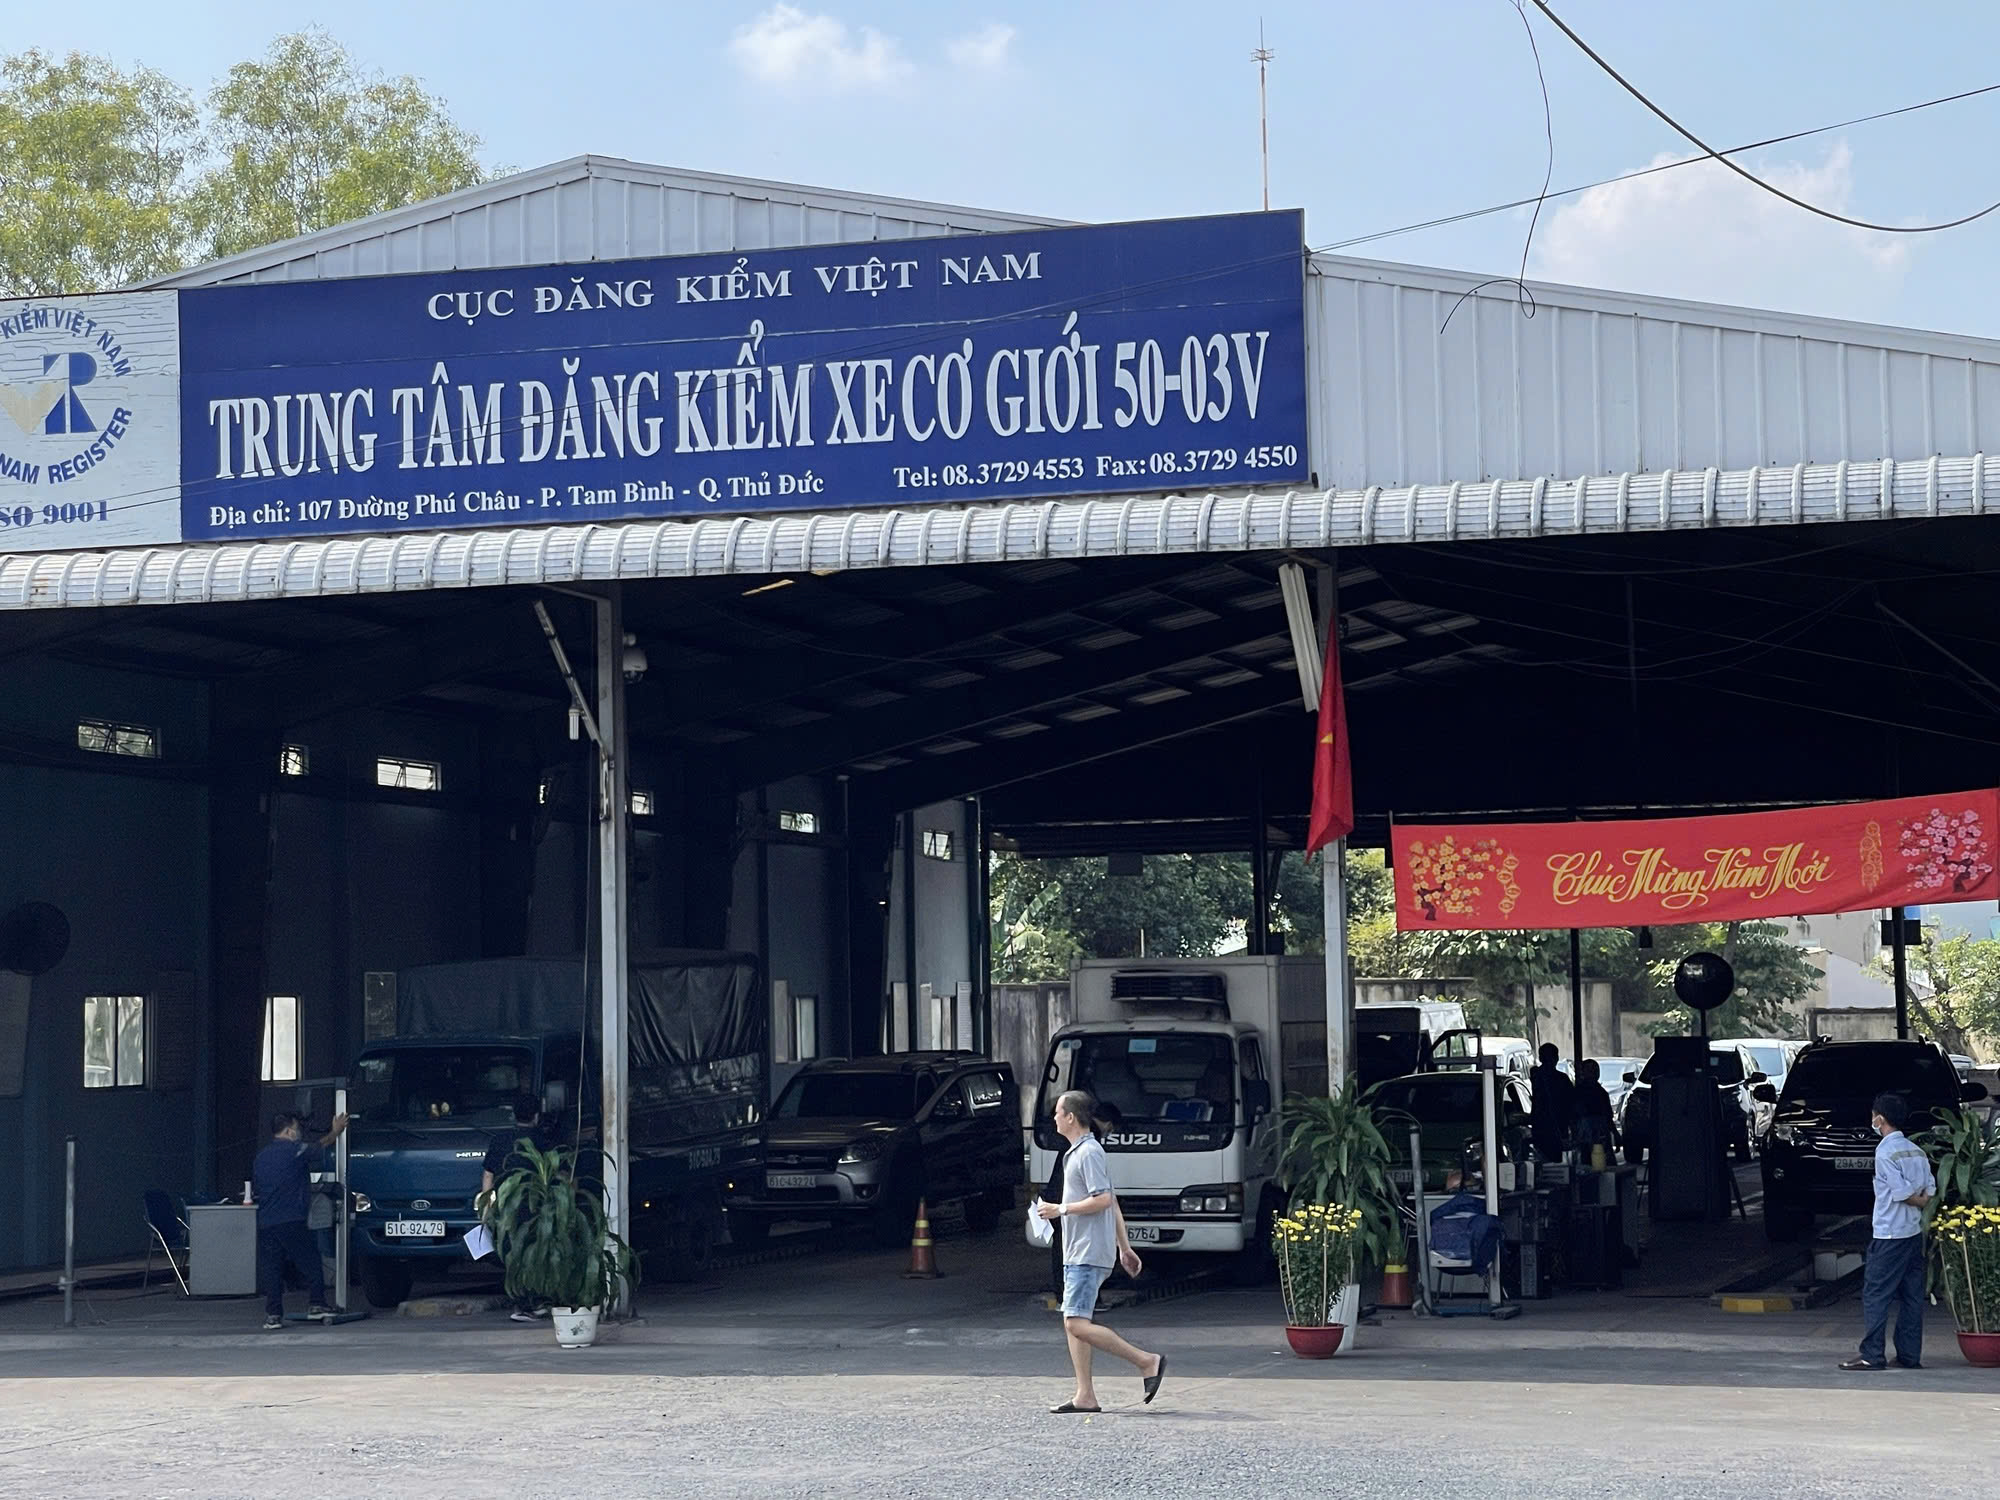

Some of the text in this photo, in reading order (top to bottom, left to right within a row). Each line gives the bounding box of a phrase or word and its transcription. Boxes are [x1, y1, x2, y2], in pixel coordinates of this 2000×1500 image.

[428, 251, 1042, 326] CỤC ĐĂNG KIỂM VIỆT NAM
[54, 308, 97, 338] VIỆT
[96, 330, 131, 378] NAM
[209, 310, 1270, 480] TRUNG TÂM ĐĂNG KIỂM XE CƠ GIỚI 50-03V
[48, 406, 132, 484] REGISTER
[894, 466, 938, 488] Tel:
[1096, 455, 1146, 477] Fax:
[1244, 444, 1298, 468] 4550
[43, 500, 107, 525] 9001
[210, 506, 247, 529] Địa
[252, 500, 291, 524] chỉ:
[298, 500, 333, 521] 107
[338, 495, 409, 520] Đường
[415, 491, 457, 515] Phú
[463, 489, 521, 512] Châu
[540, 487, 562, 508] P.
[568, 485, 617, 506] Tam
[623, 480, 675, 503] Bình
[699, 477, 722, 502] Q.
[727, 472, 772, 498] Thủ
[778, 469, 824, 496] Đức
[1546, 842, 1836, 910] Chúc Mừng Năm Mới
[1100, 1133, 1161, 1145] ISUZU
